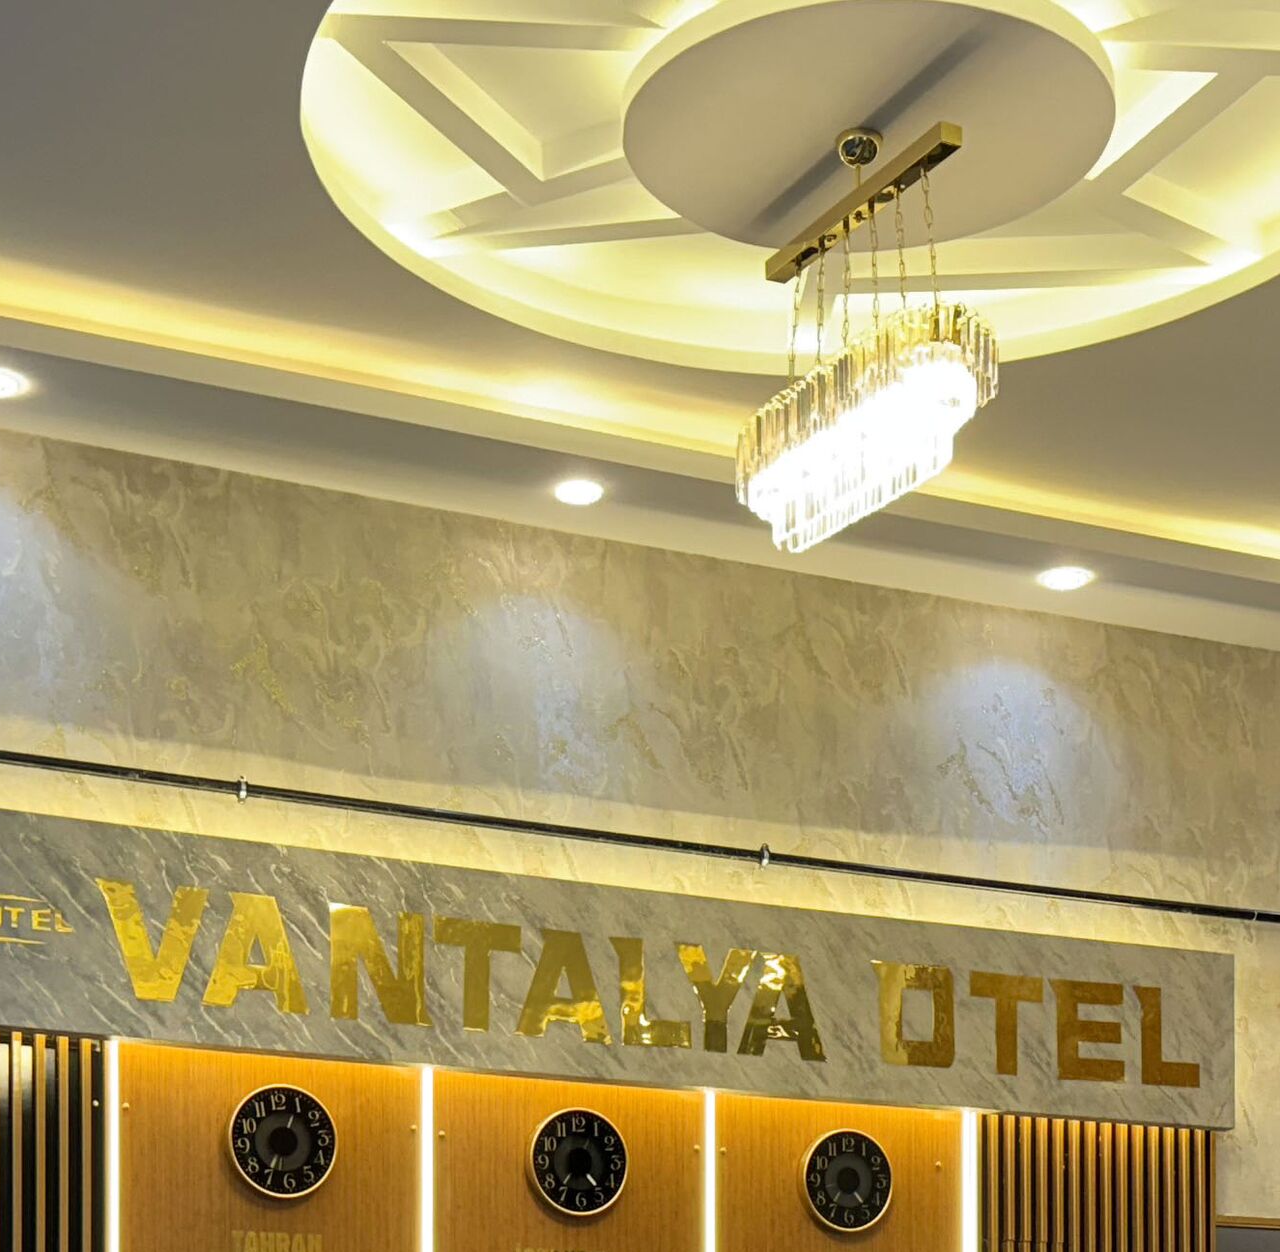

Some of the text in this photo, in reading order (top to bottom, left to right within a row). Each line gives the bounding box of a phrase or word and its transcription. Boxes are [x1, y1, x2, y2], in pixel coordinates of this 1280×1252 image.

[95, 877, 1201, 1087] VANTALYA OTEL
[254, 1101, 266, 1118] 11
[271, 1094, 286, 1110] 12
[242, 1118, 256, 1134] 10
[308, 1111, 320, 1127] 2
[237, 1137, 250, 1153] 9
[318, 1130, 329, 1146] 3
[247, 1157, 259, 1173] 8
[314, 1150, 324, 1165] 4
[264, 1169, 274, 1185] 7
[284, 1173, 296, 1189] 6
[303, 1166, 314, 1182] 5
